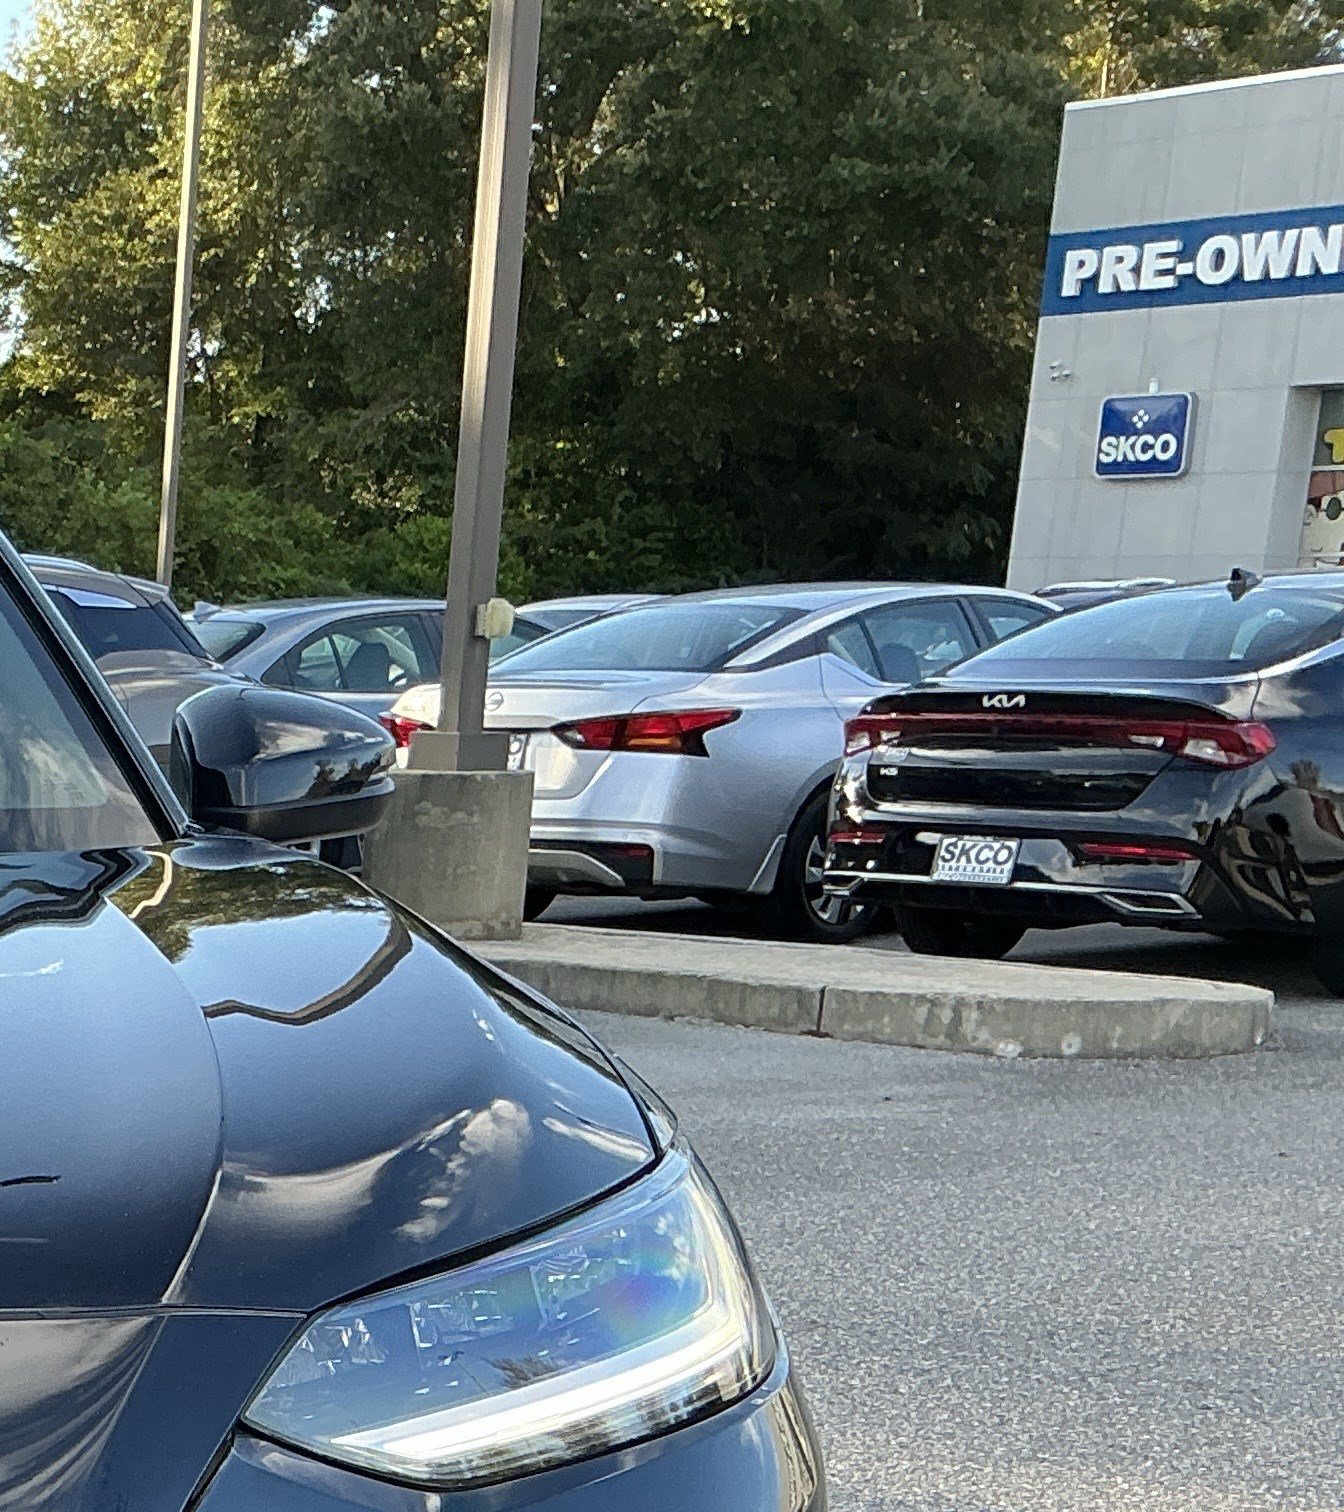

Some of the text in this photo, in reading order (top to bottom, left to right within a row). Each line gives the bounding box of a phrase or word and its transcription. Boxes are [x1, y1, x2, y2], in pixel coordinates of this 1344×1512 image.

[1060, 224, 1344, 298] PRE-OWN
[1098, 432, 1178, 464] SKCO
[940, 841, 1013, 866] SKCO
